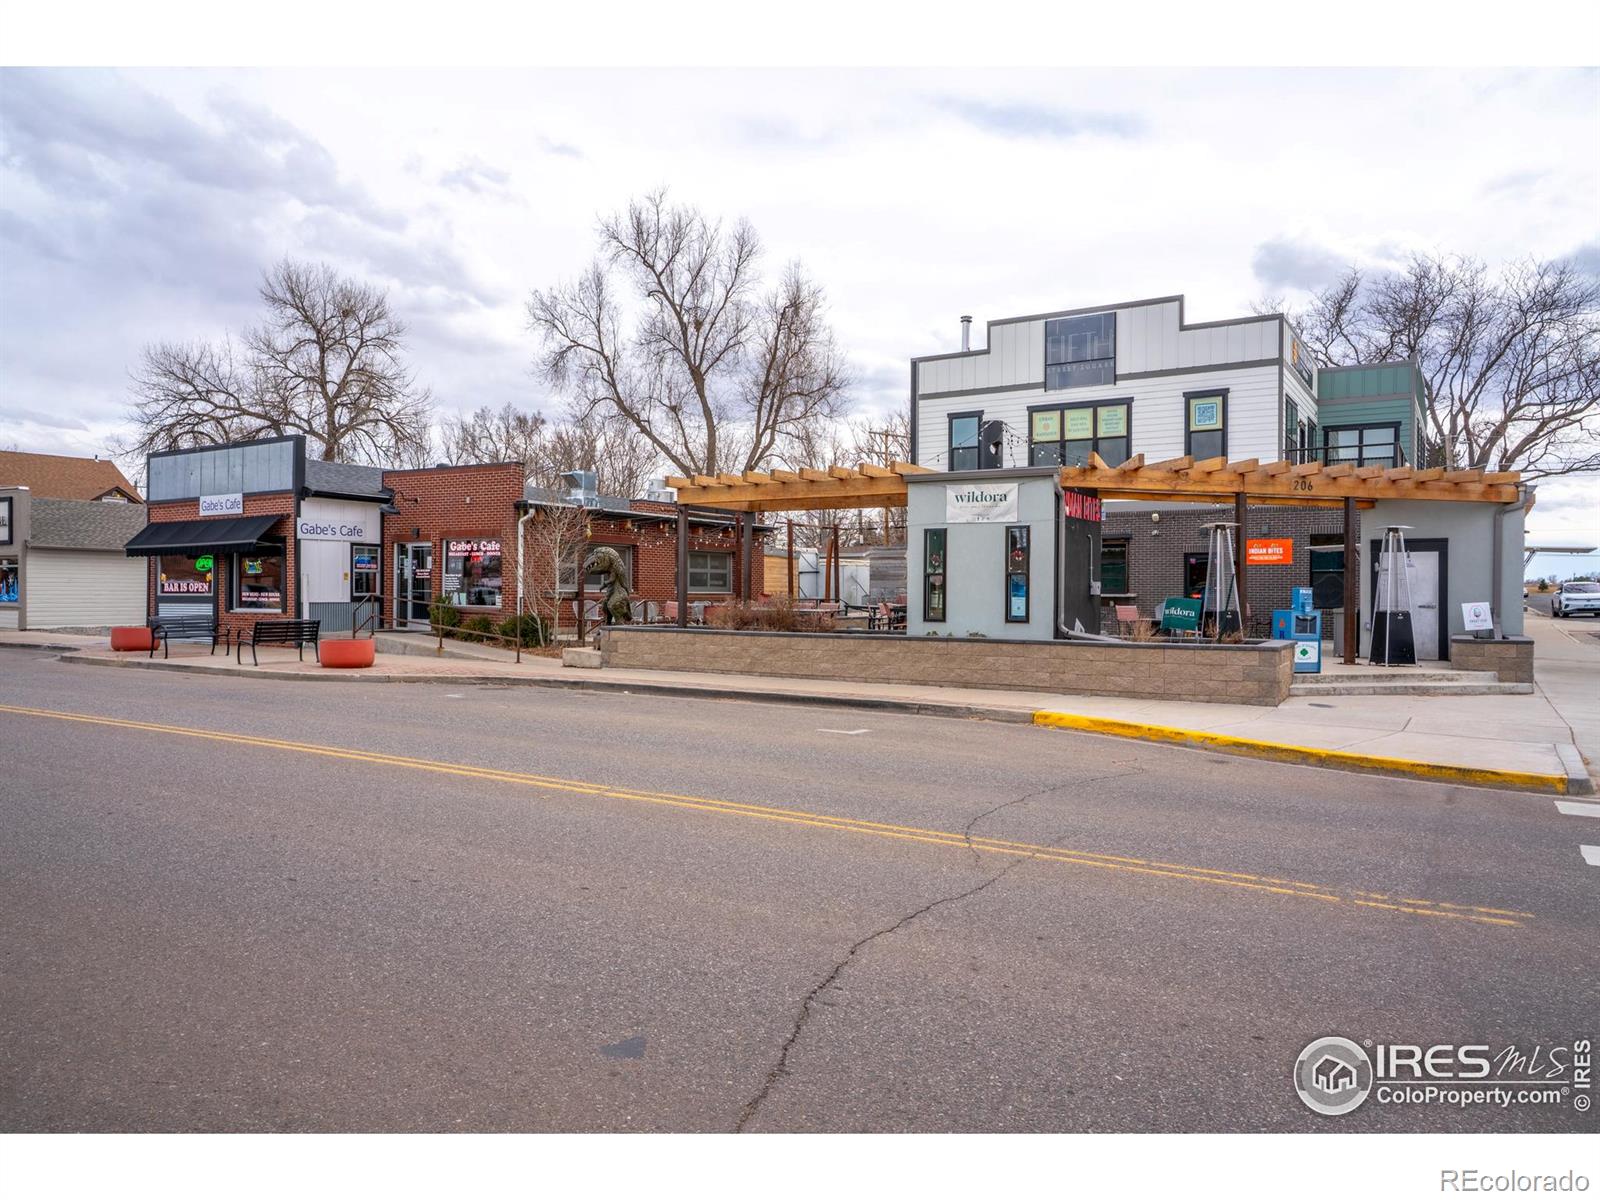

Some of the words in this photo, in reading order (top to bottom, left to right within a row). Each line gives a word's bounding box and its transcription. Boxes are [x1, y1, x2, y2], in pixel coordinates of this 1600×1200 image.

[1294, 480, 1313, 491] 206
[955, 491, 1007, 503] wildora
[201, 499, 224, 512] Gabe's
[225, 498, 241, 510] Cafe
[300, 523, 337, 536] Gabe's
[339, 525, 363, 537] Cafe
[450, 541, 478, 551] Gabe's
[480, 541, 501, 551] Cafe
[163, 583, 179, 592] BAR
[180, 583, 187, 592] IS
[188, 583, 209, 592] OPEN
